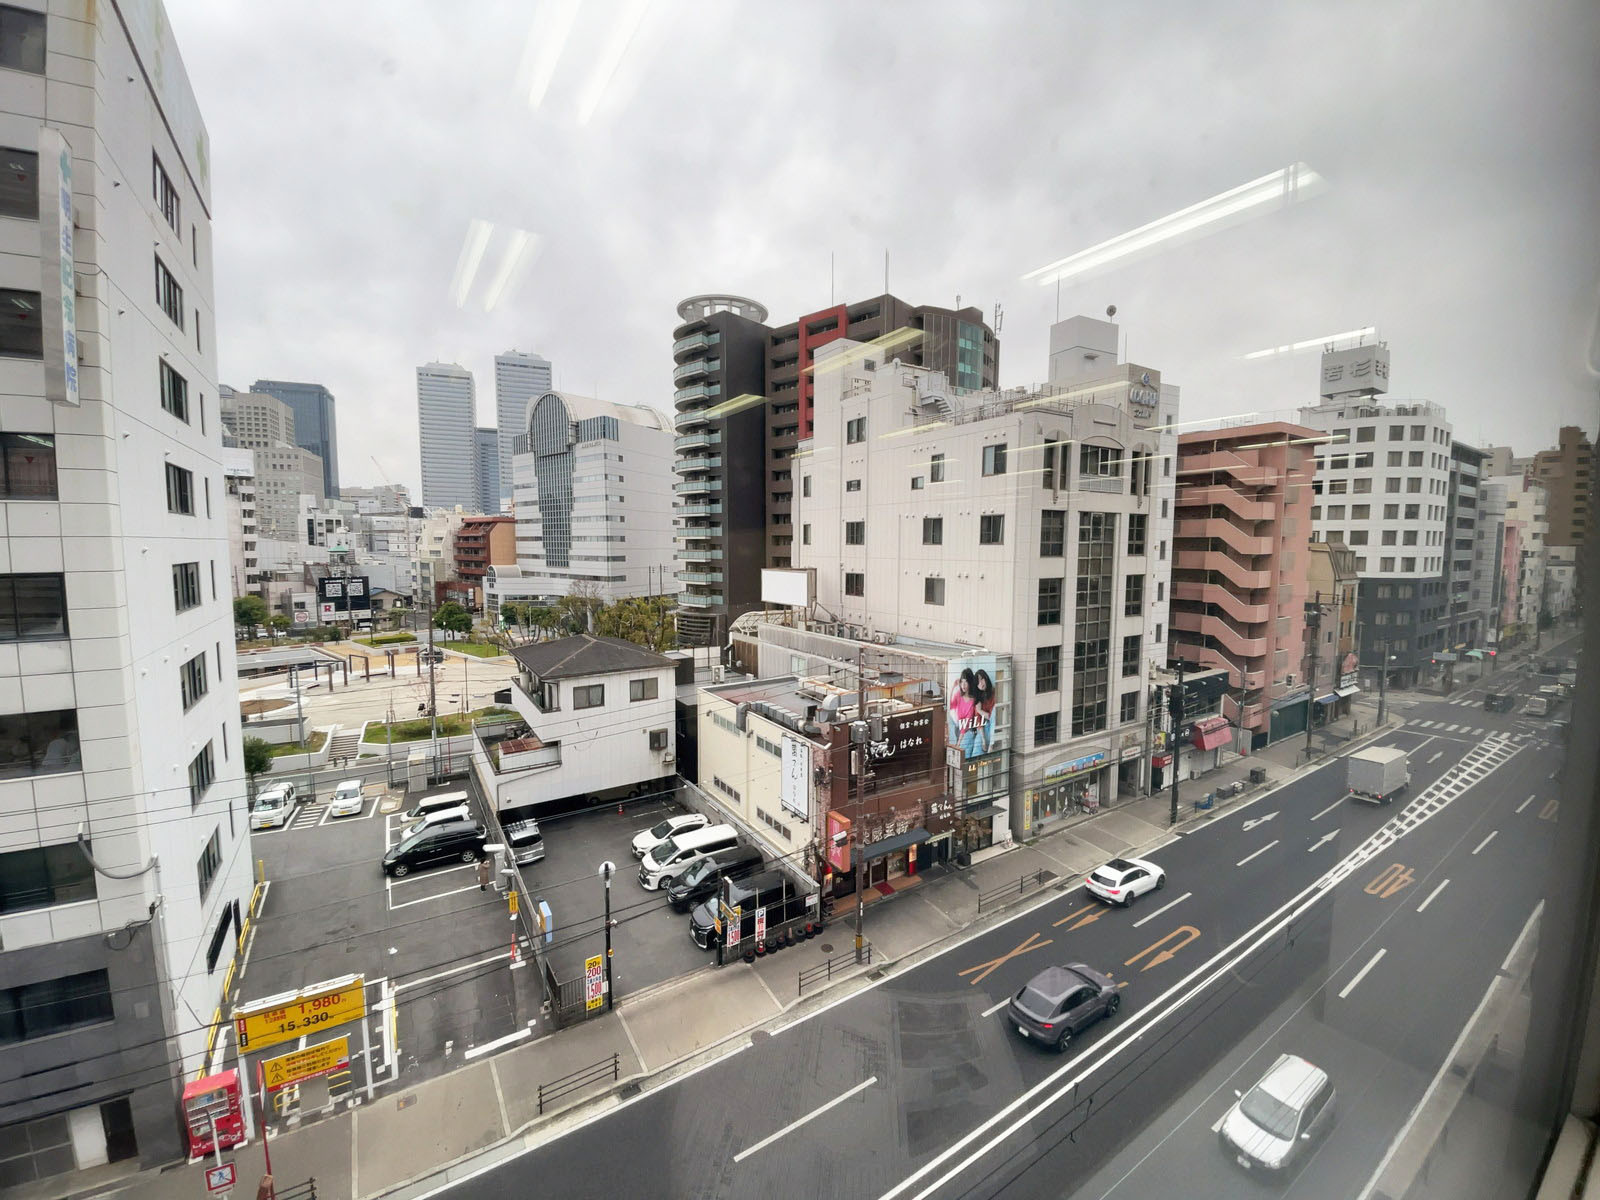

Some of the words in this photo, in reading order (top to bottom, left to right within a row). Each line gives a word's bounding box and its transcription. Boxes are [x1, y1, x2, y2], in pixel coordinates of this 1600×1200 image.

[958, 715, 987, 730] WiLL
[899, 736, 923, 750] はなれ
[587, 966, 602, 979] 200
